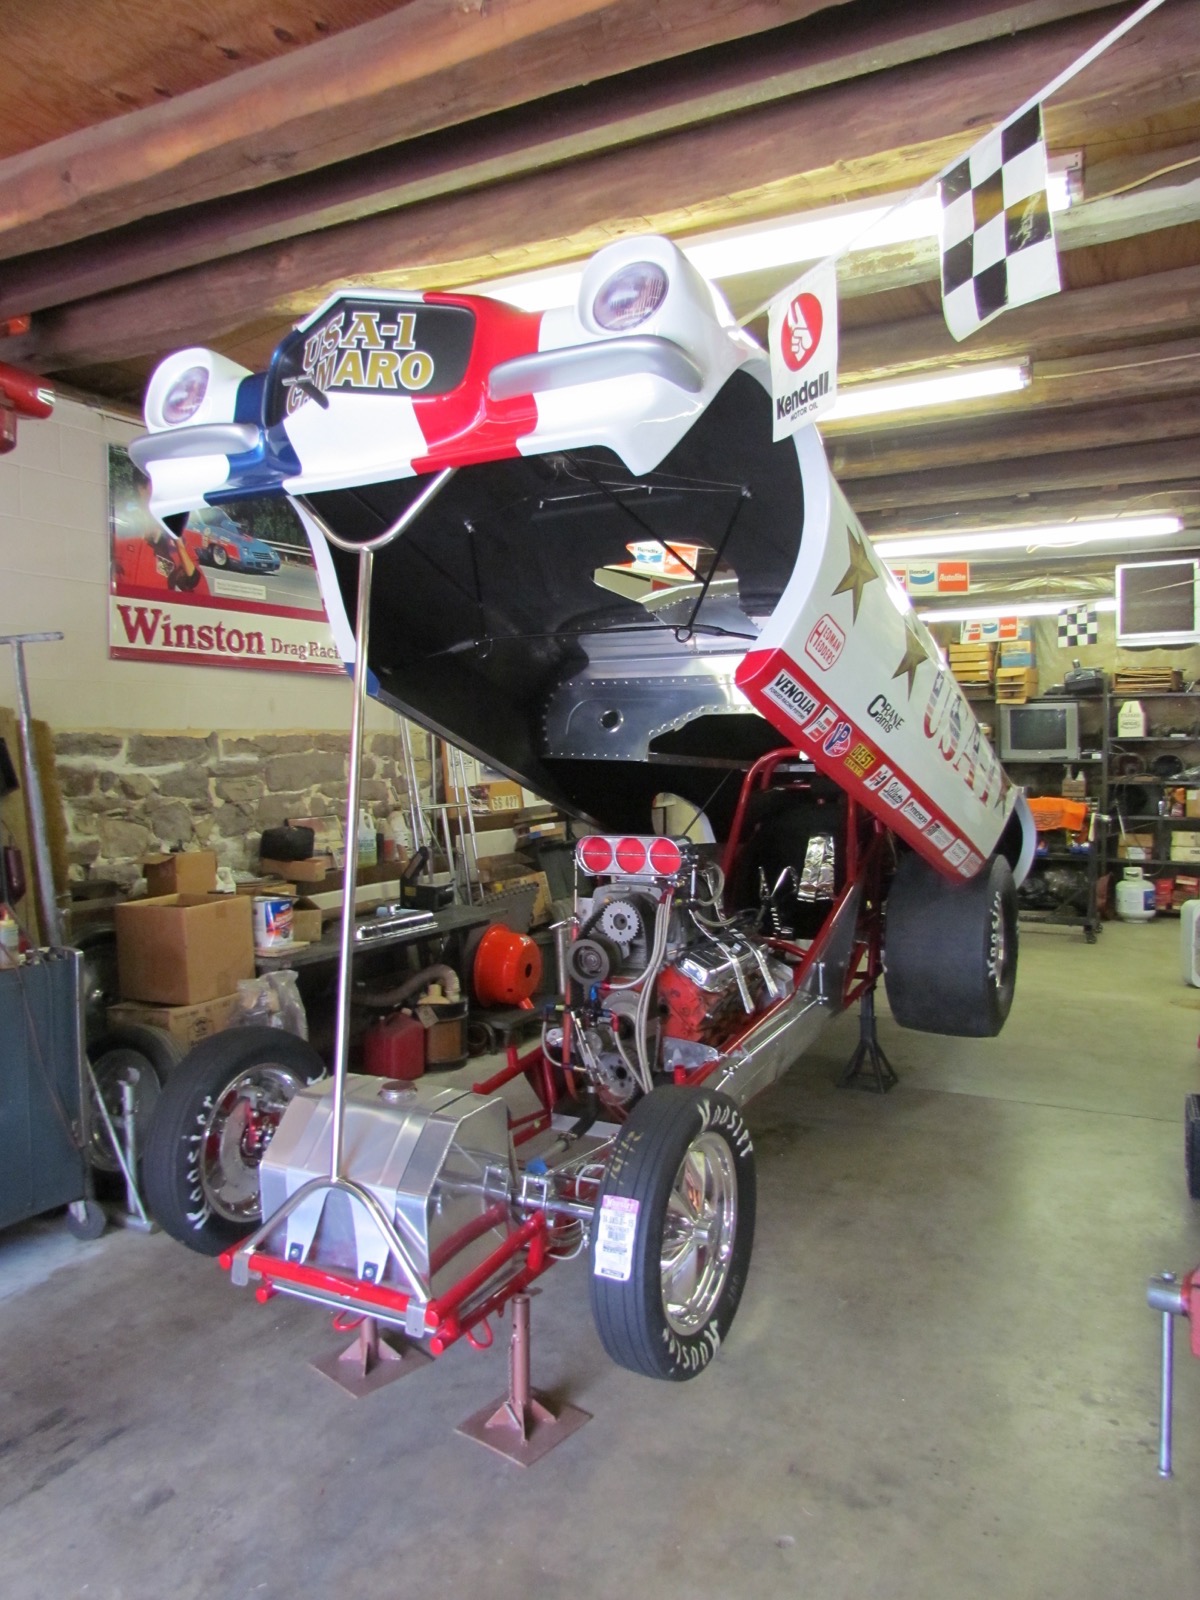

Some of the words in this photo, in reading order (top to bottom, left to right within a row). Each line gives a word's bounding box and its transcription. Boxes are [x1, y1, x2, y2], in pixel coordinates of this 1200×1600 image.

[303, 311, 417, 372] USA-1
[776, 371, 829, 420] Kendall
[790, 406, 808, 421] MOTOR
[808, 402, 818, 411] OIL
[116, 603, 266, 655] Winston
[271, 637, 307, 660] Drag
[809, 620, 841, 652] HEDMAN
[775, 674, 816, 716] VENOLIA
[851, 744, 875, 768] DEIST
